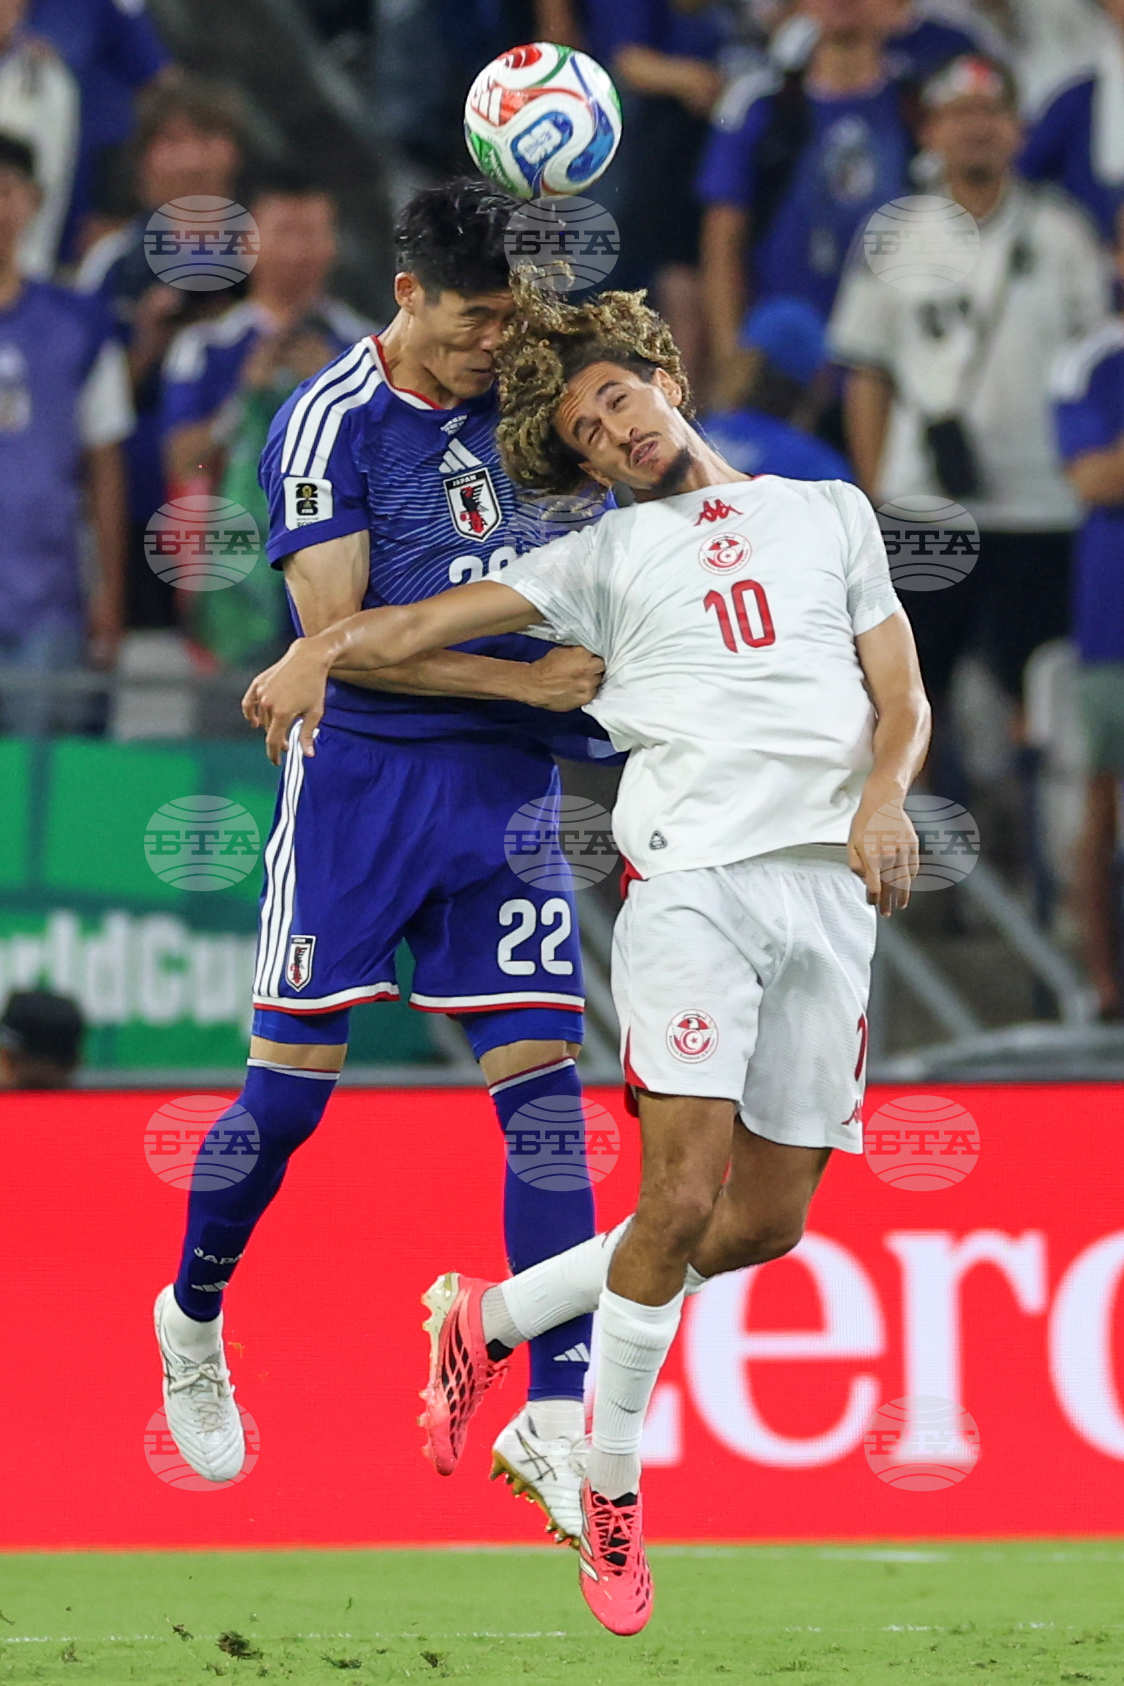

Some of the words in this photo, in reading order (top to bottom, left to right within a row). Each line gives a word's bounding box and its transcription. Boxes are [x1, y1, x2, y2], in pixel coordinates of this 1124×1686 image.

[452, 474, 477, 487] JAPAN
[703, 579, 776, 653] 10
[497, 897, 573, 975] 22
